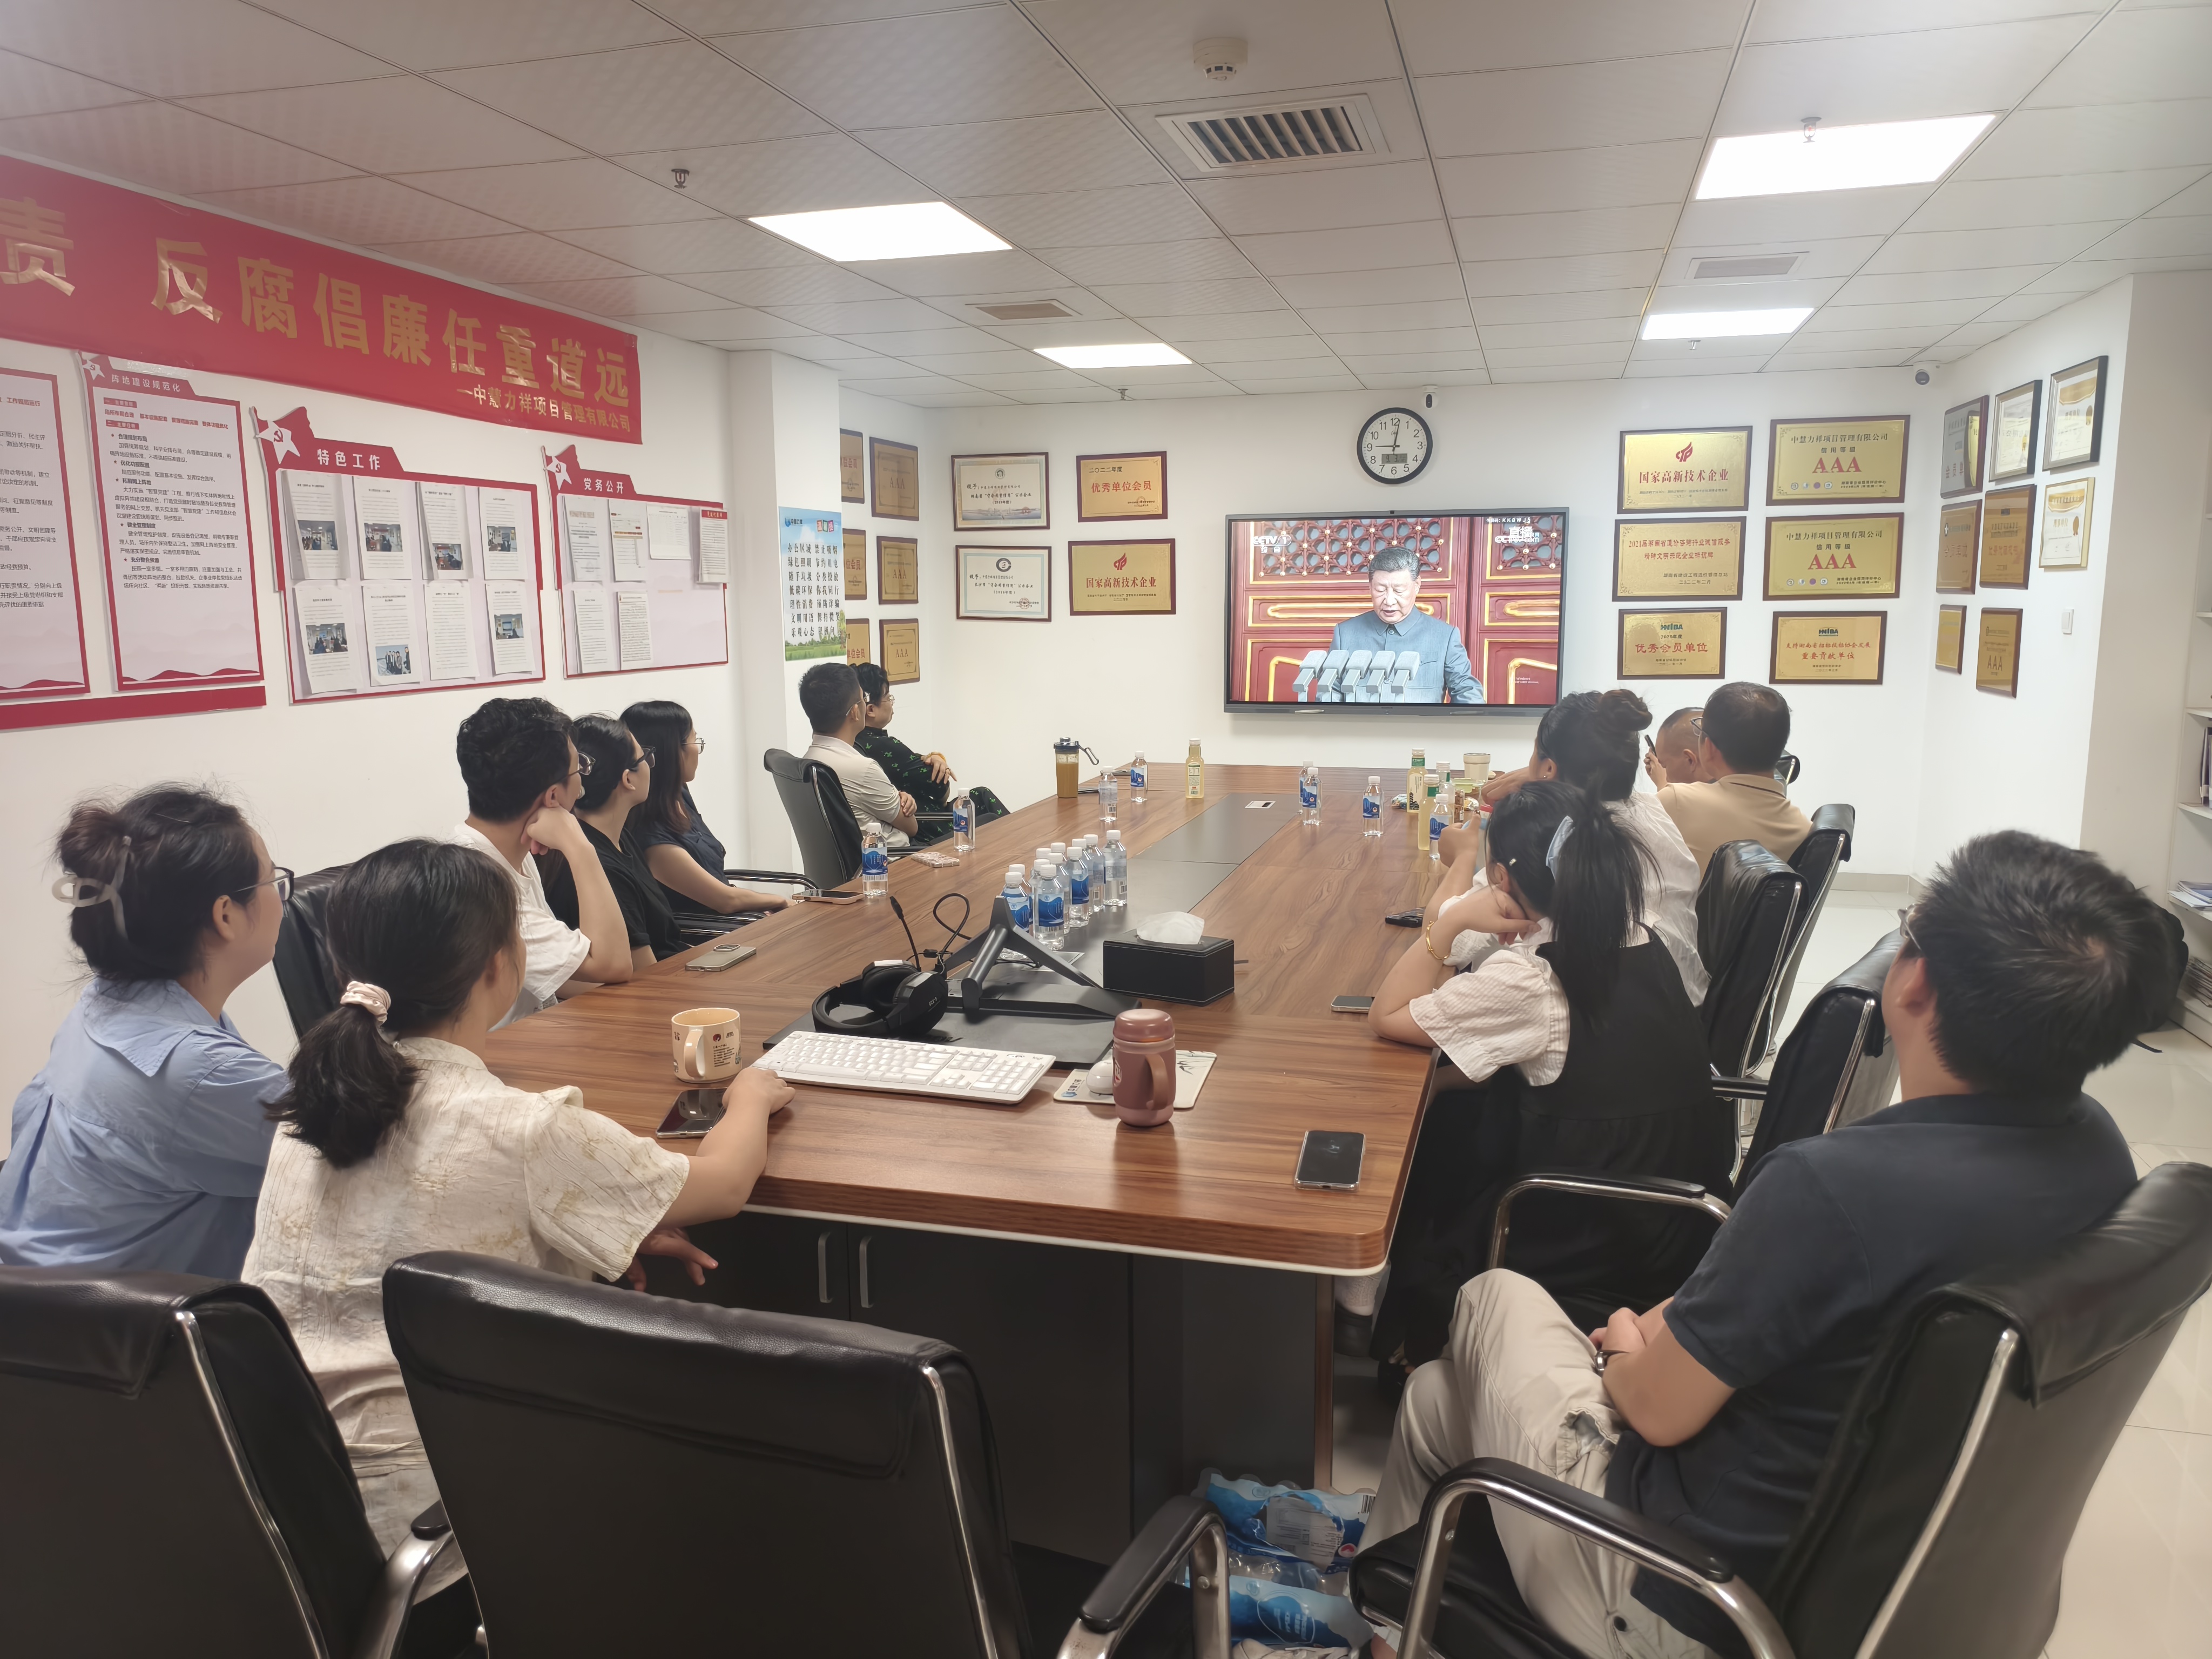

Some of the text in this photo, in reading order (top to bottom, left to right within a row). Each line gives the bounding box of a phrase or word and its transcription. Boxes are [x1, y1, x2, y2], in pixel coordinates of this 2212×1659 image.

[151, 237, 629, 407] 反腐倡廉任重道远
[111, 374, 180, 392] 阵地建设规范化
[1379, 421, 1386, 430] 11
[1390, 417, 1400, 427] 12
[1406, 421, 1409, 429] 1
[1370, 431, 1379, 440] 10
[1413, 429, 1419, 437] 2
[1791, 433, 1888, 444] 中慧力祥项目管理有限公司
[1366, 443, 1373, 451] 9
[1417, 441, 1423, 450] 3
[317, 449, 380, 470] 特色工作
[1370, 455, 1376, 464] 8
[1412, 455, 1419, 463] 4
[1379, 464, 1385, 473] 7
[1403, 464, 1410, 472] 5
[1812, 456, 1862, 474] AAA
[1391, 467, 1397, 475] 6
[1640, 469, 1728, 484] 国家高新技术企业
[584, 477, 624, 494] 党务公开
[1091, 481, 1151, 493] 优秀单位会员
[1508, 526, 1533, 538] 直播
[1786, 530, 1882, 541] 中慧力祥项目管理有限公司
[788, 543, 838, 555] 办公区域 禁止吸烟
[788, 556, 838, 568] 绿色照明 节约用电
[1808, 553, 1857, 570] AAA
[788, 571, 839, 582] 随手垃圾 分类投放
[893, 569, 907, 579] AAA
[1086, 576, 1157, 588] 国家高新技术企业
[790, 585, 839, 595] 低碳环保 你我同行
[790, 599, 839, 609] 理性消费 谨防诈骗
[791, 613, 813, 624] 文明用语
[791, 626, 814, 637] 乐观心态
[895, 648, 908, 658] AAA
[1635, 642, 1708, 653] 优秀会员单位
[1802, 651, 1854, 660] 重要贡献单位
[1987, 655, 2002, 671] AAA
